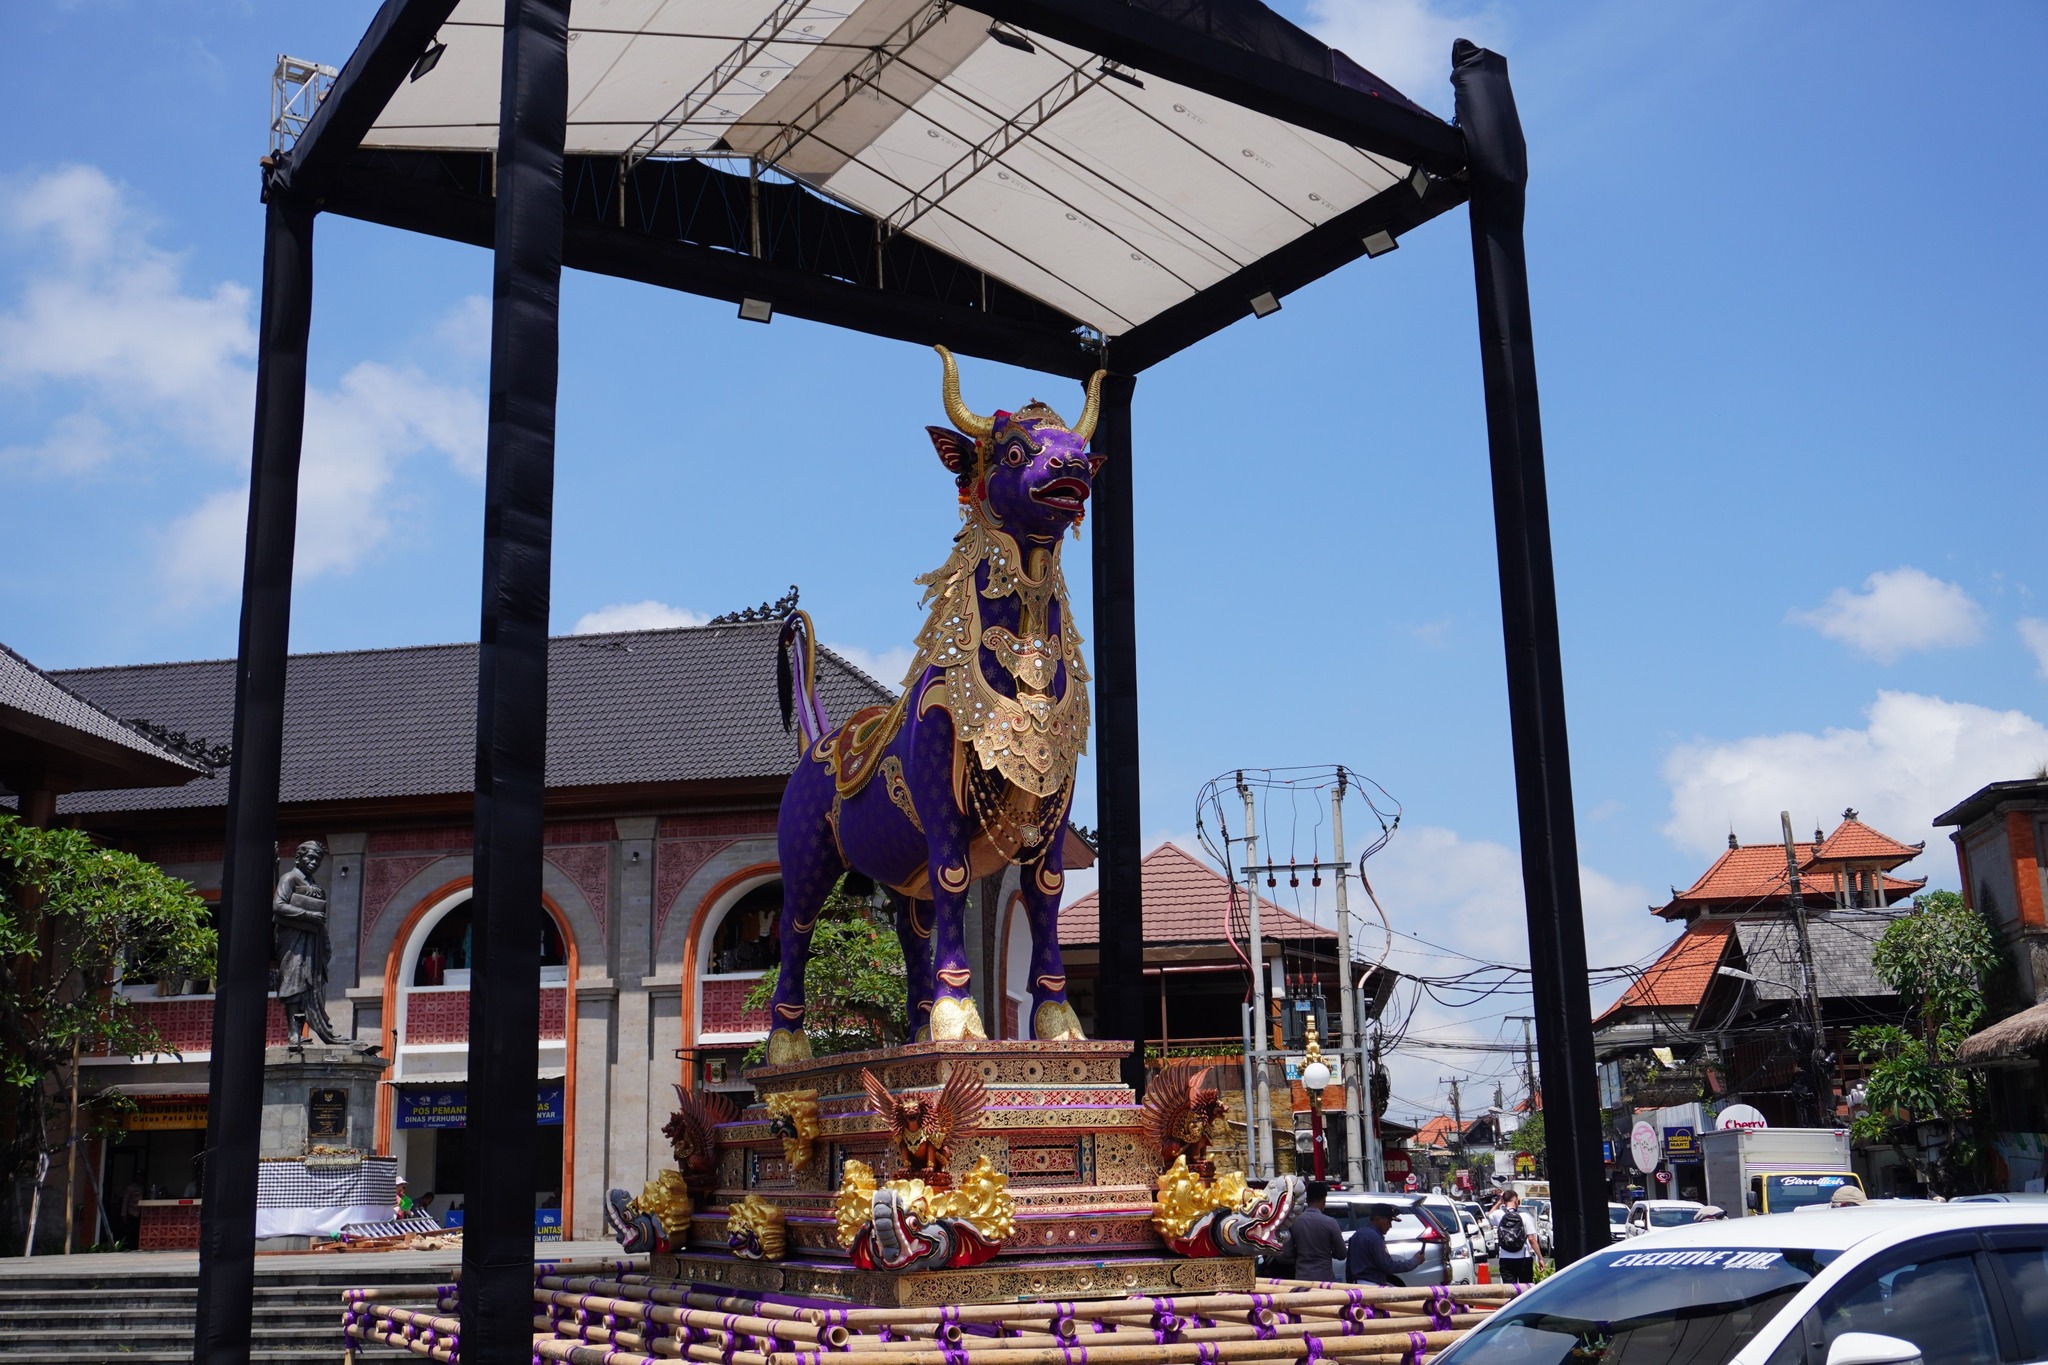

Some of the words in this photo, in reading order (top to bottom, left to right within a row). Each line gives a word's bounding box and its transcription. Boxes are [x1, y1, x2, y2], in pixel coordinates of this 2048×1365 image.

[413, 1107, 430, 1115] POS
[432, 1106, 467, 1114] PEMANT
[537, 1103, 550, 1111] AS
[1725, 1119, 1765, 1129] Cherry
[1780, 1176, 1845, 1186] Bismillah
[537, 1225, 562, 1234] LINTAS
[1608, 1251, 1734, 1268] EXECUTIVE
